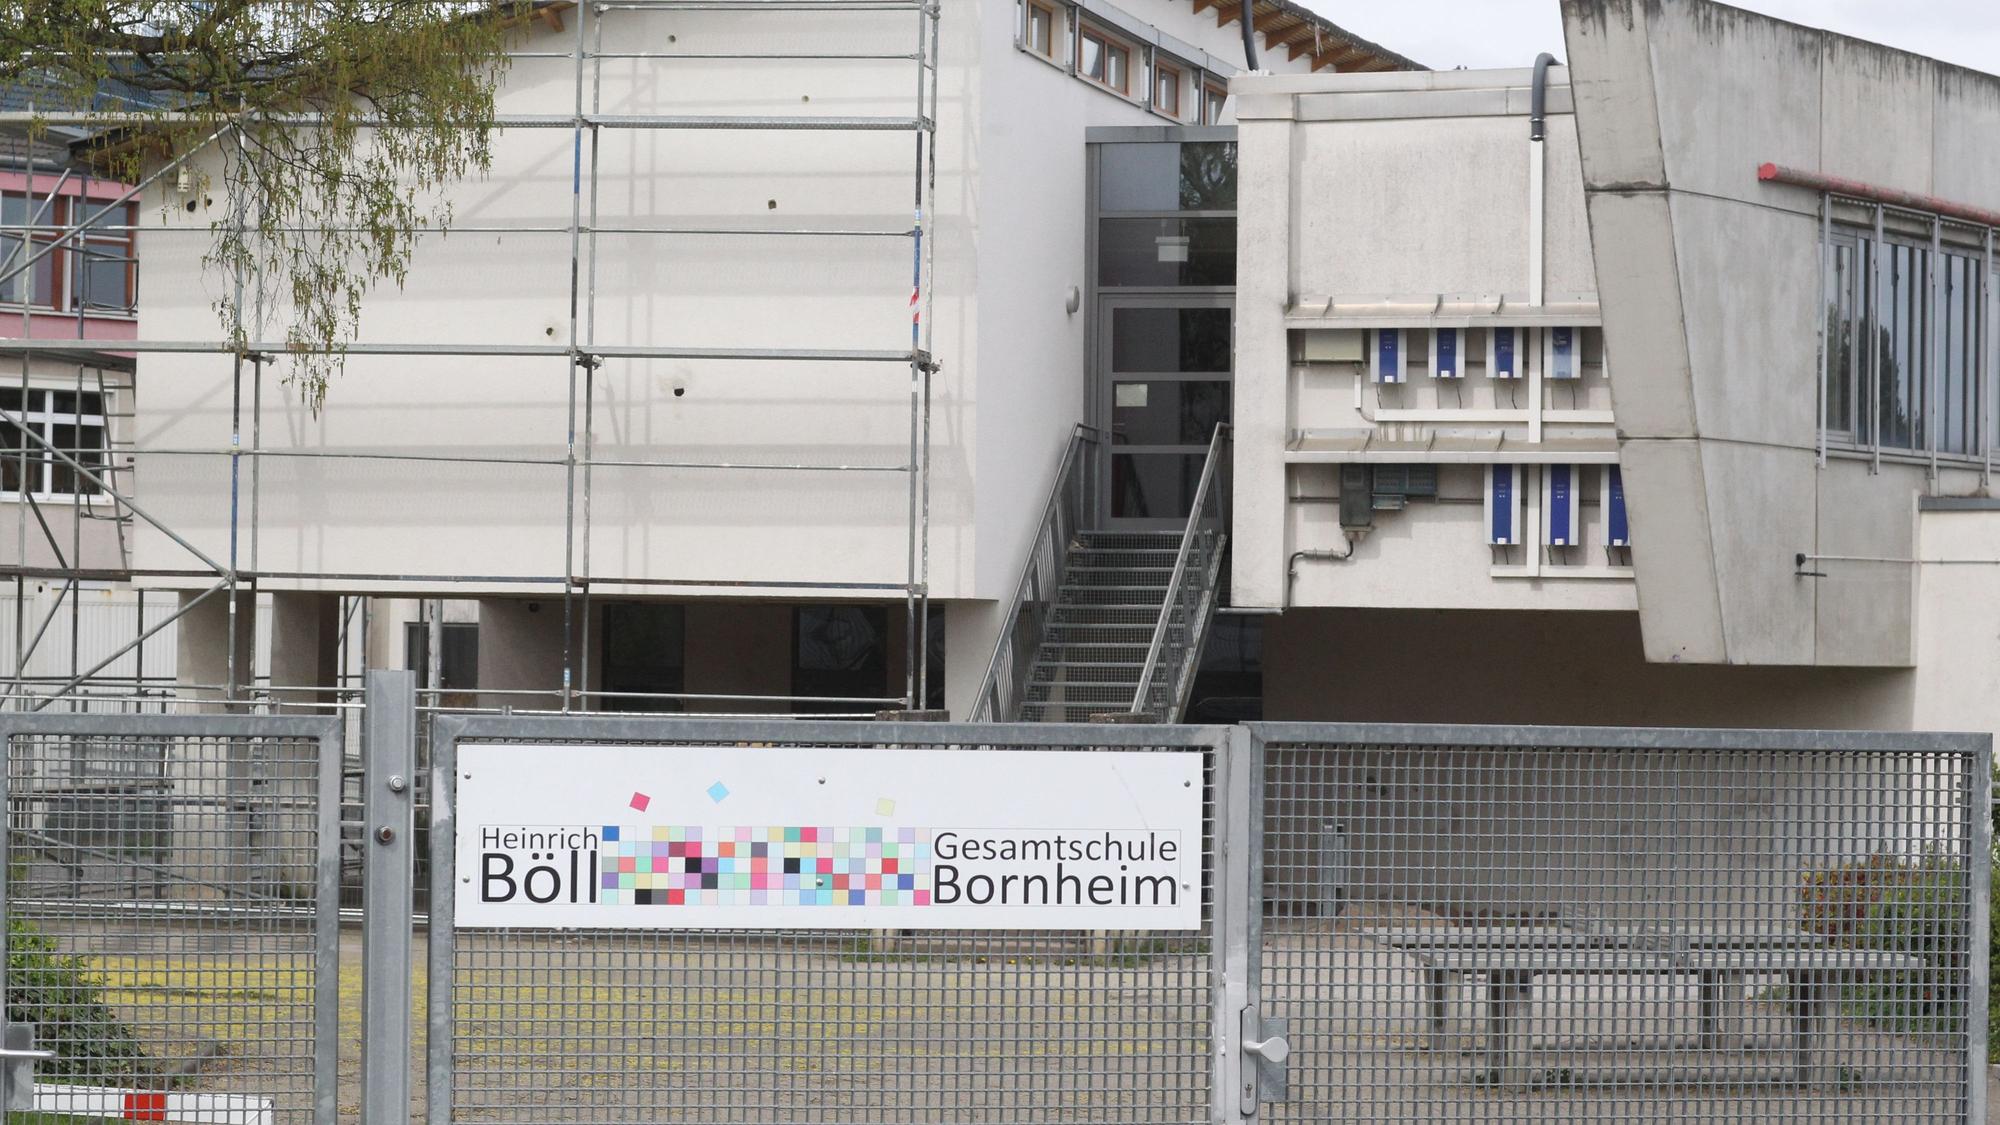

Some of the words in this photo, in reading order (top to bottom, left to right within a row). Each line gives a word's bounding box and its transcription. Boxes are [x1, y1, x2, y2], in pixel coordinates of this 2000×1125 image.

[482, 826, 598, 850] Heinrich
[934, 832, 1178, 862] Gesamtschule
[481, 850, 598, 904] Böll
[934, 862, 1178, 905] Bornheim
